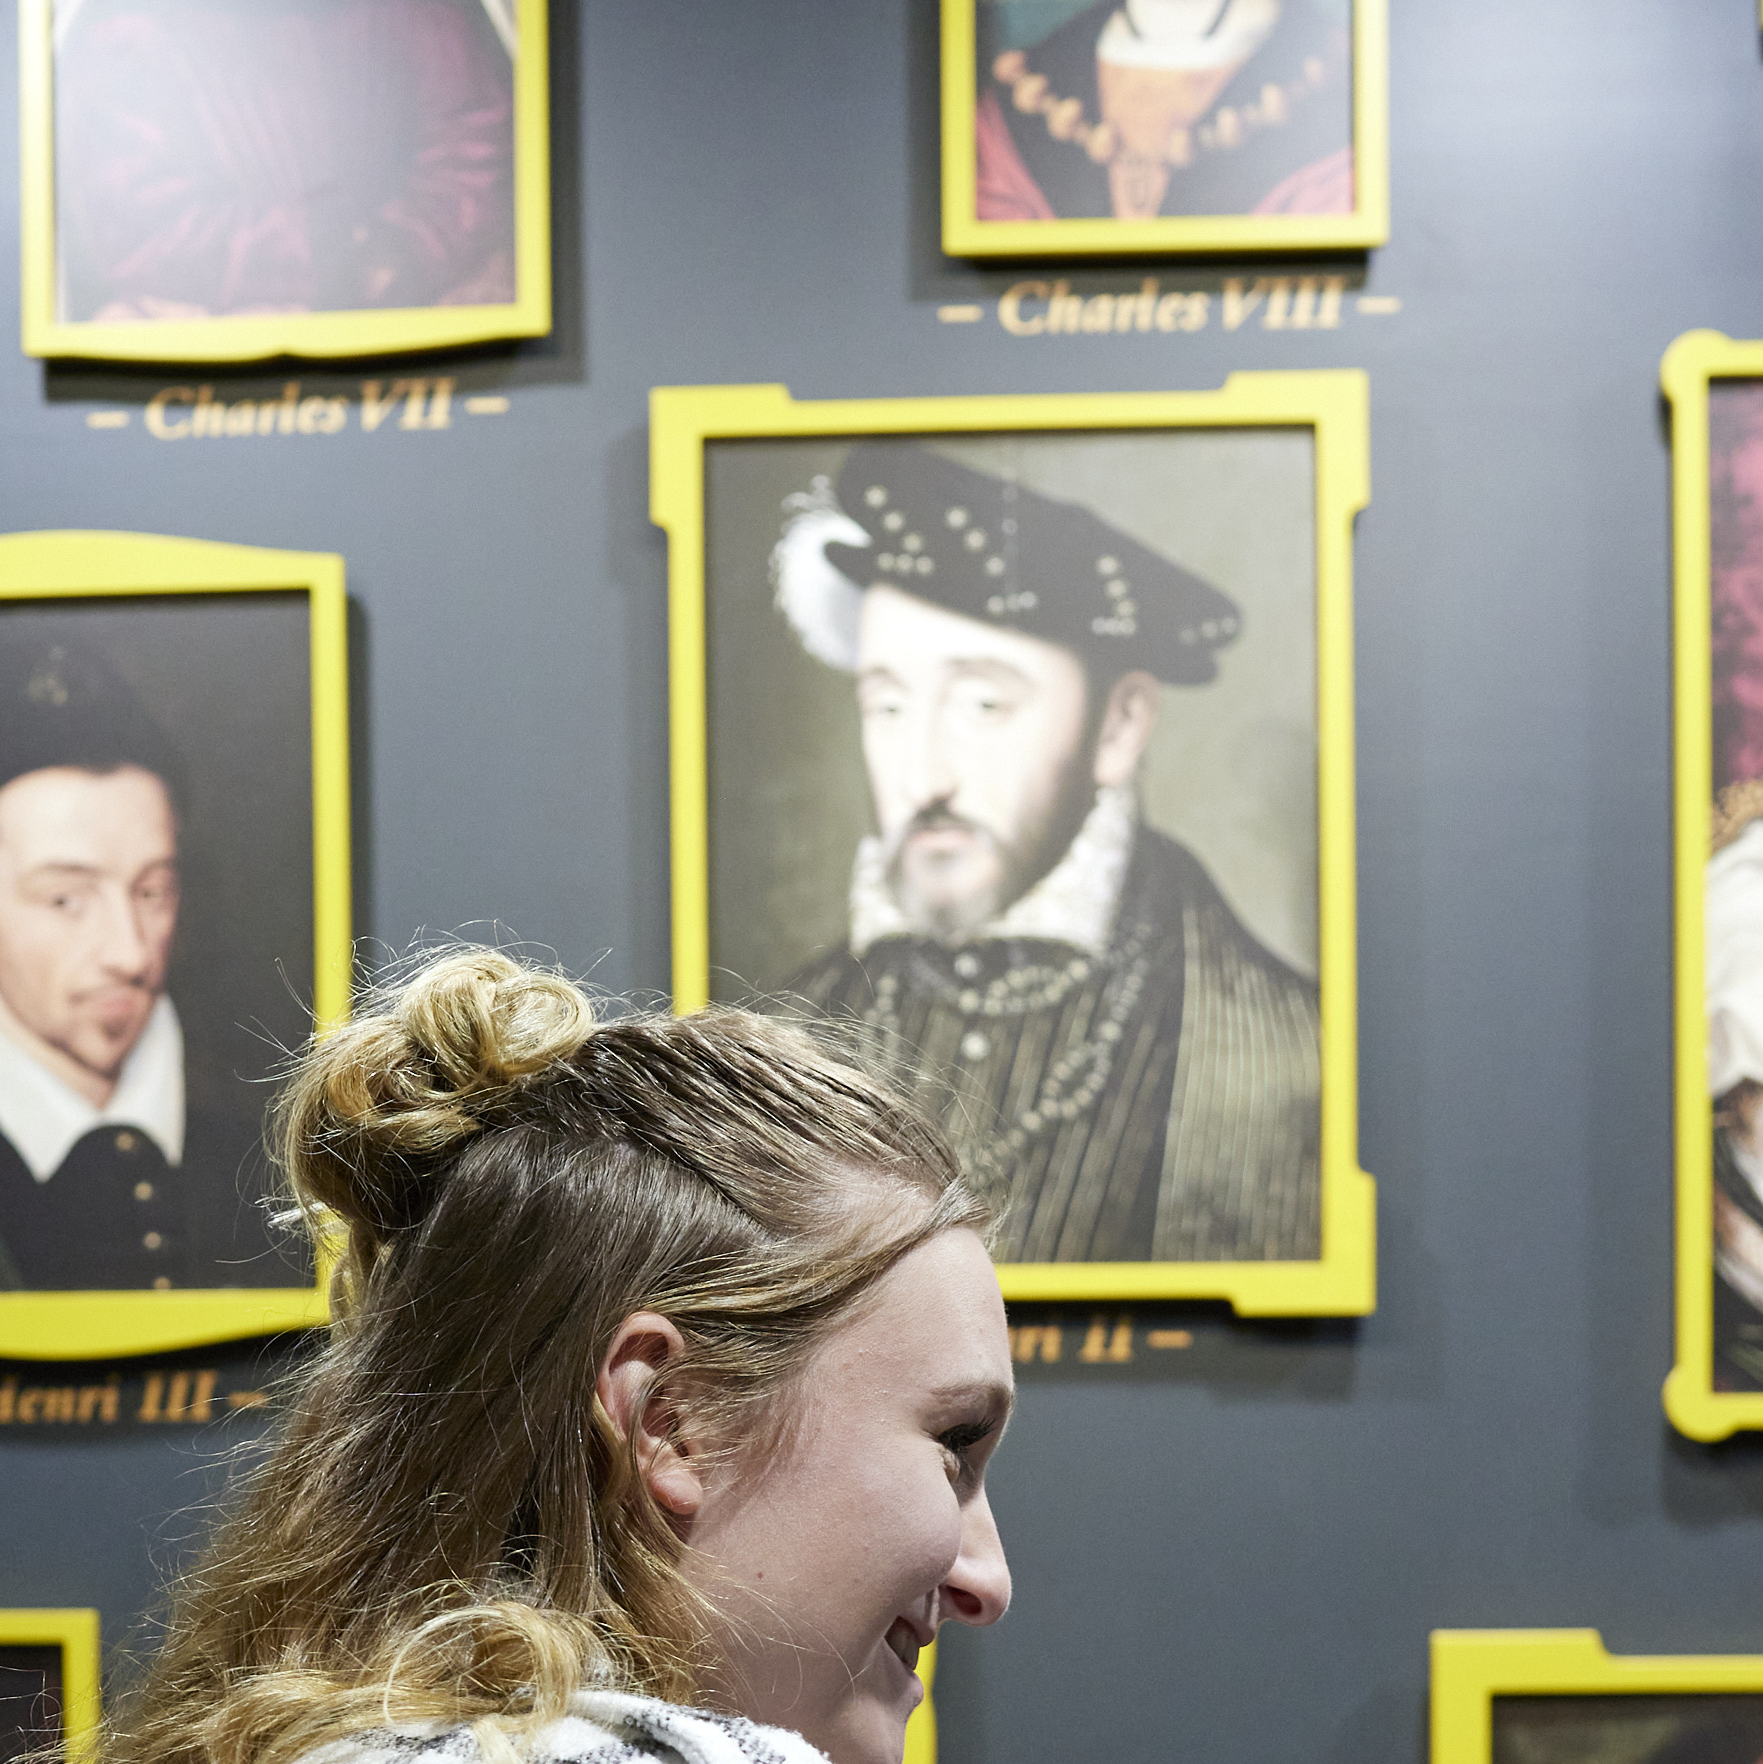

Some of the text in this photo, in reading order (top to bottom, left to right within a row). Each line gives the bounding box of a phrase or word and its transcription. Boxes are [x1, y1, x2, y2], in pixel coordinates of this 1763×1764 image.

[997, 275, 1346, 337] Charles VIII
[143, 377, 458, 441] Charles VII
[139, 1369, 218, 1423] III
